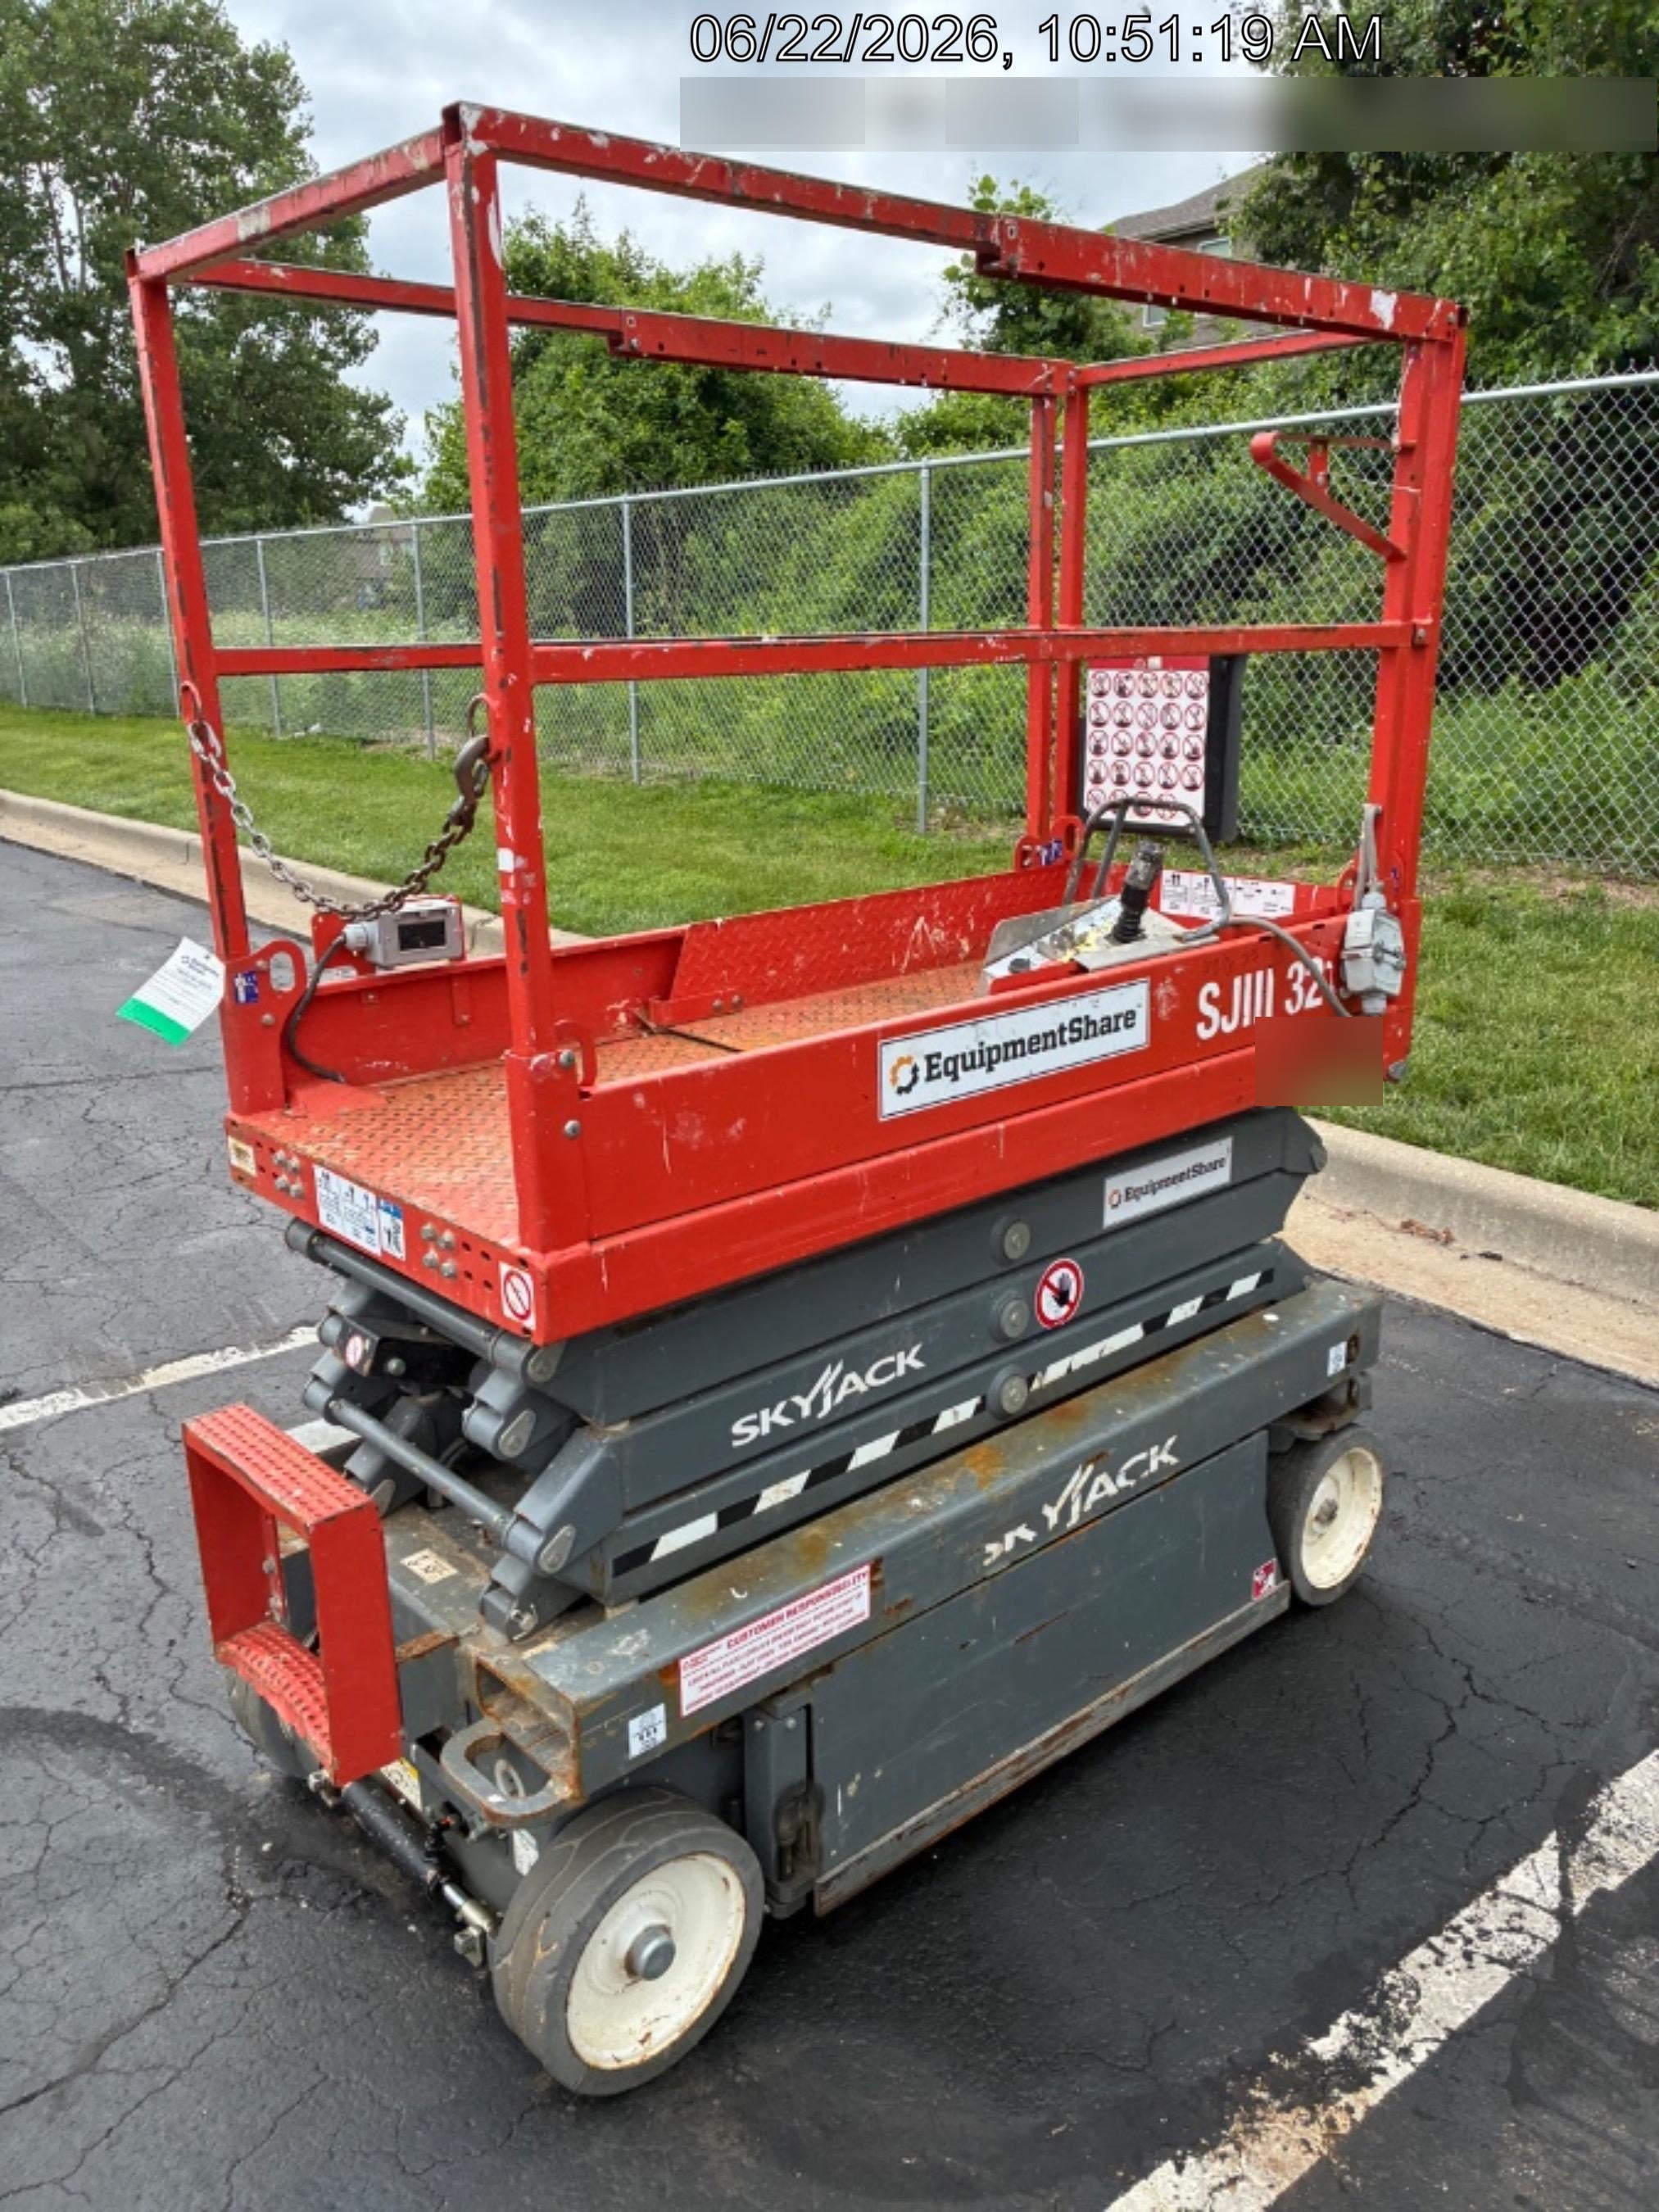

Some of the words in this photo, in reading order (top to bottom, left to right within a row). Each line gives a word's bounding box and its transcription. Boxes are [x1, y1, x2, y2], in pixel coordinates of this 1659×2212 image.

[925, 1005, 1137, 1083] EquipmentShare
[1123, 1156, 1226, 1202] EquipmentShare
[731, 1344, 927, 1448] SKYJACK
